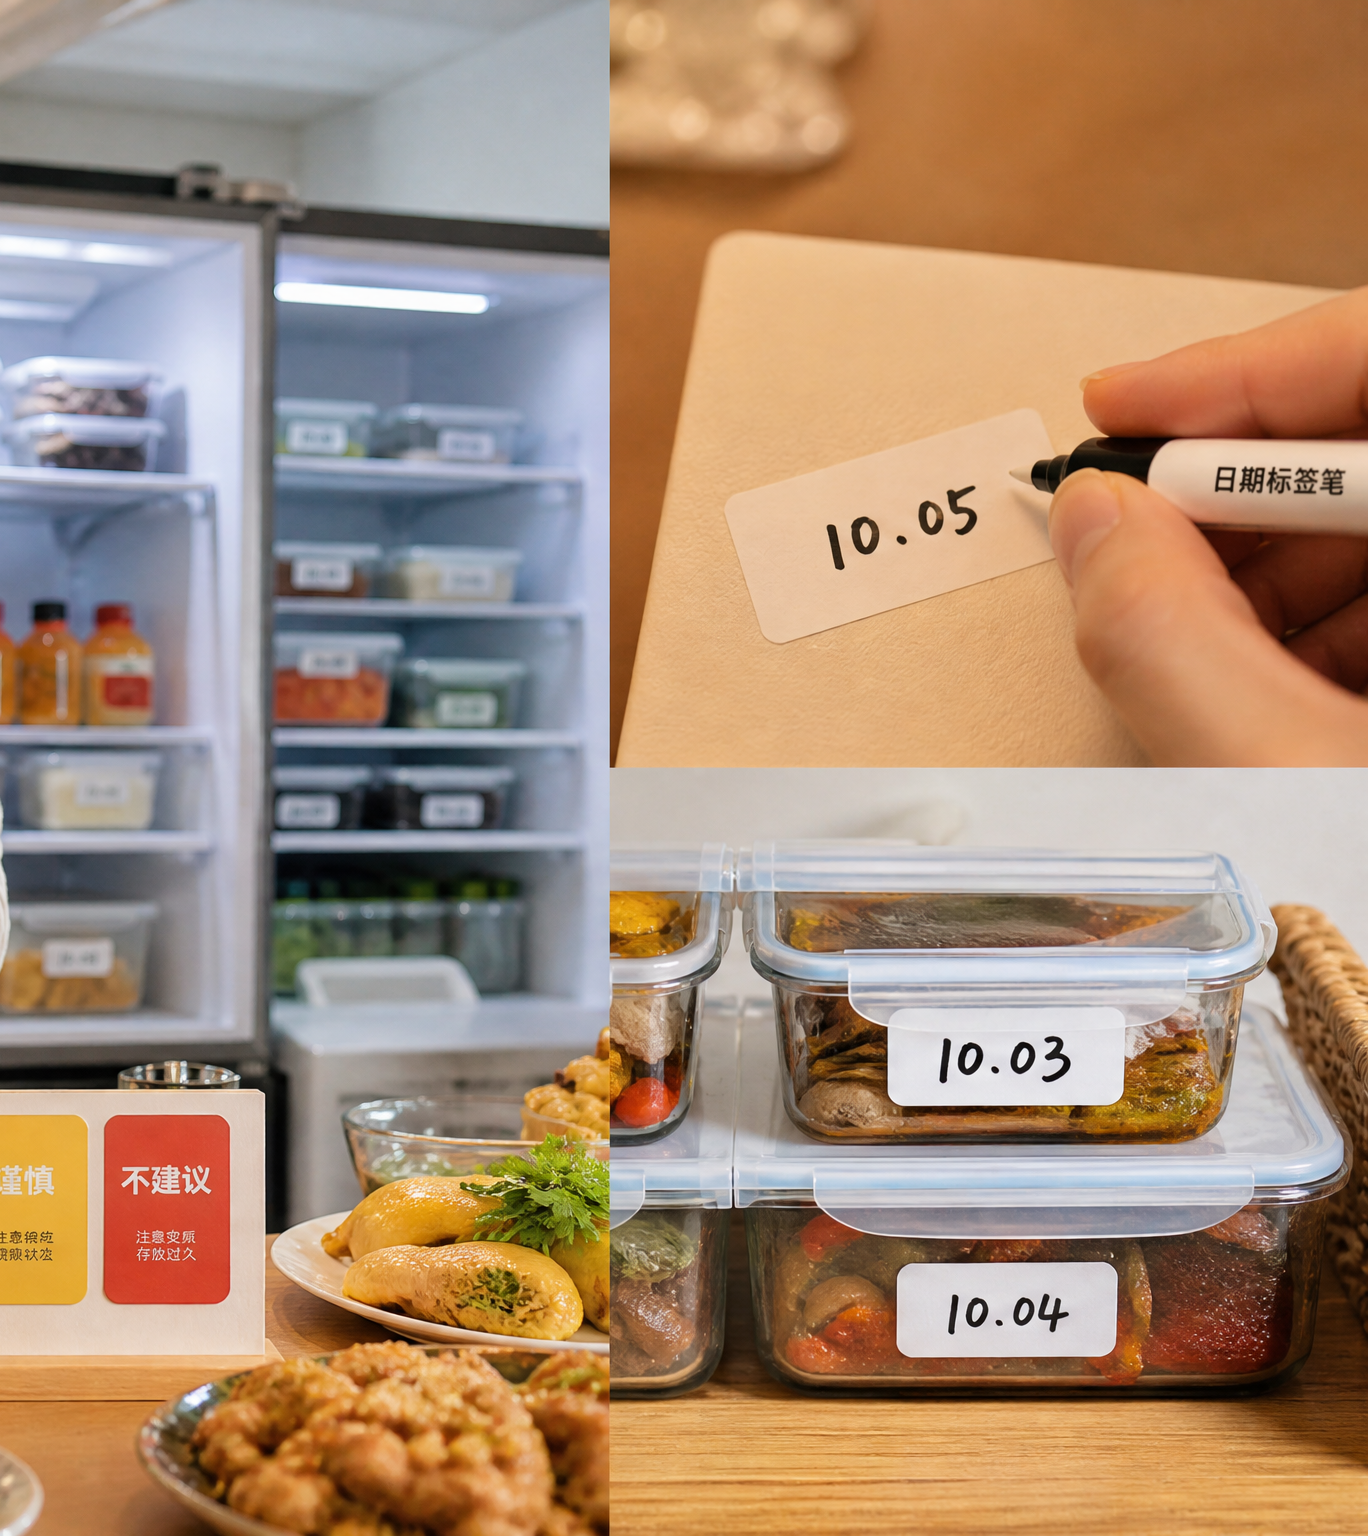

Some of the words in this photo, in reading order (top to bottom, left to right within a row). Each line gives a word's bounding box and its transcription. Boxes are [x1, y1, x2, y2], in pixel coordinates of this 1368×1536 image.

[1214, 466, 1346, 496] 日期标签笔
[826, 485, 978, 571] 10.05
[938, 1035, 1072, 1084] 10.03
[120, 1164, 213, 1196] 不建议
[947, 1293, 1070, 1335] 10.04
